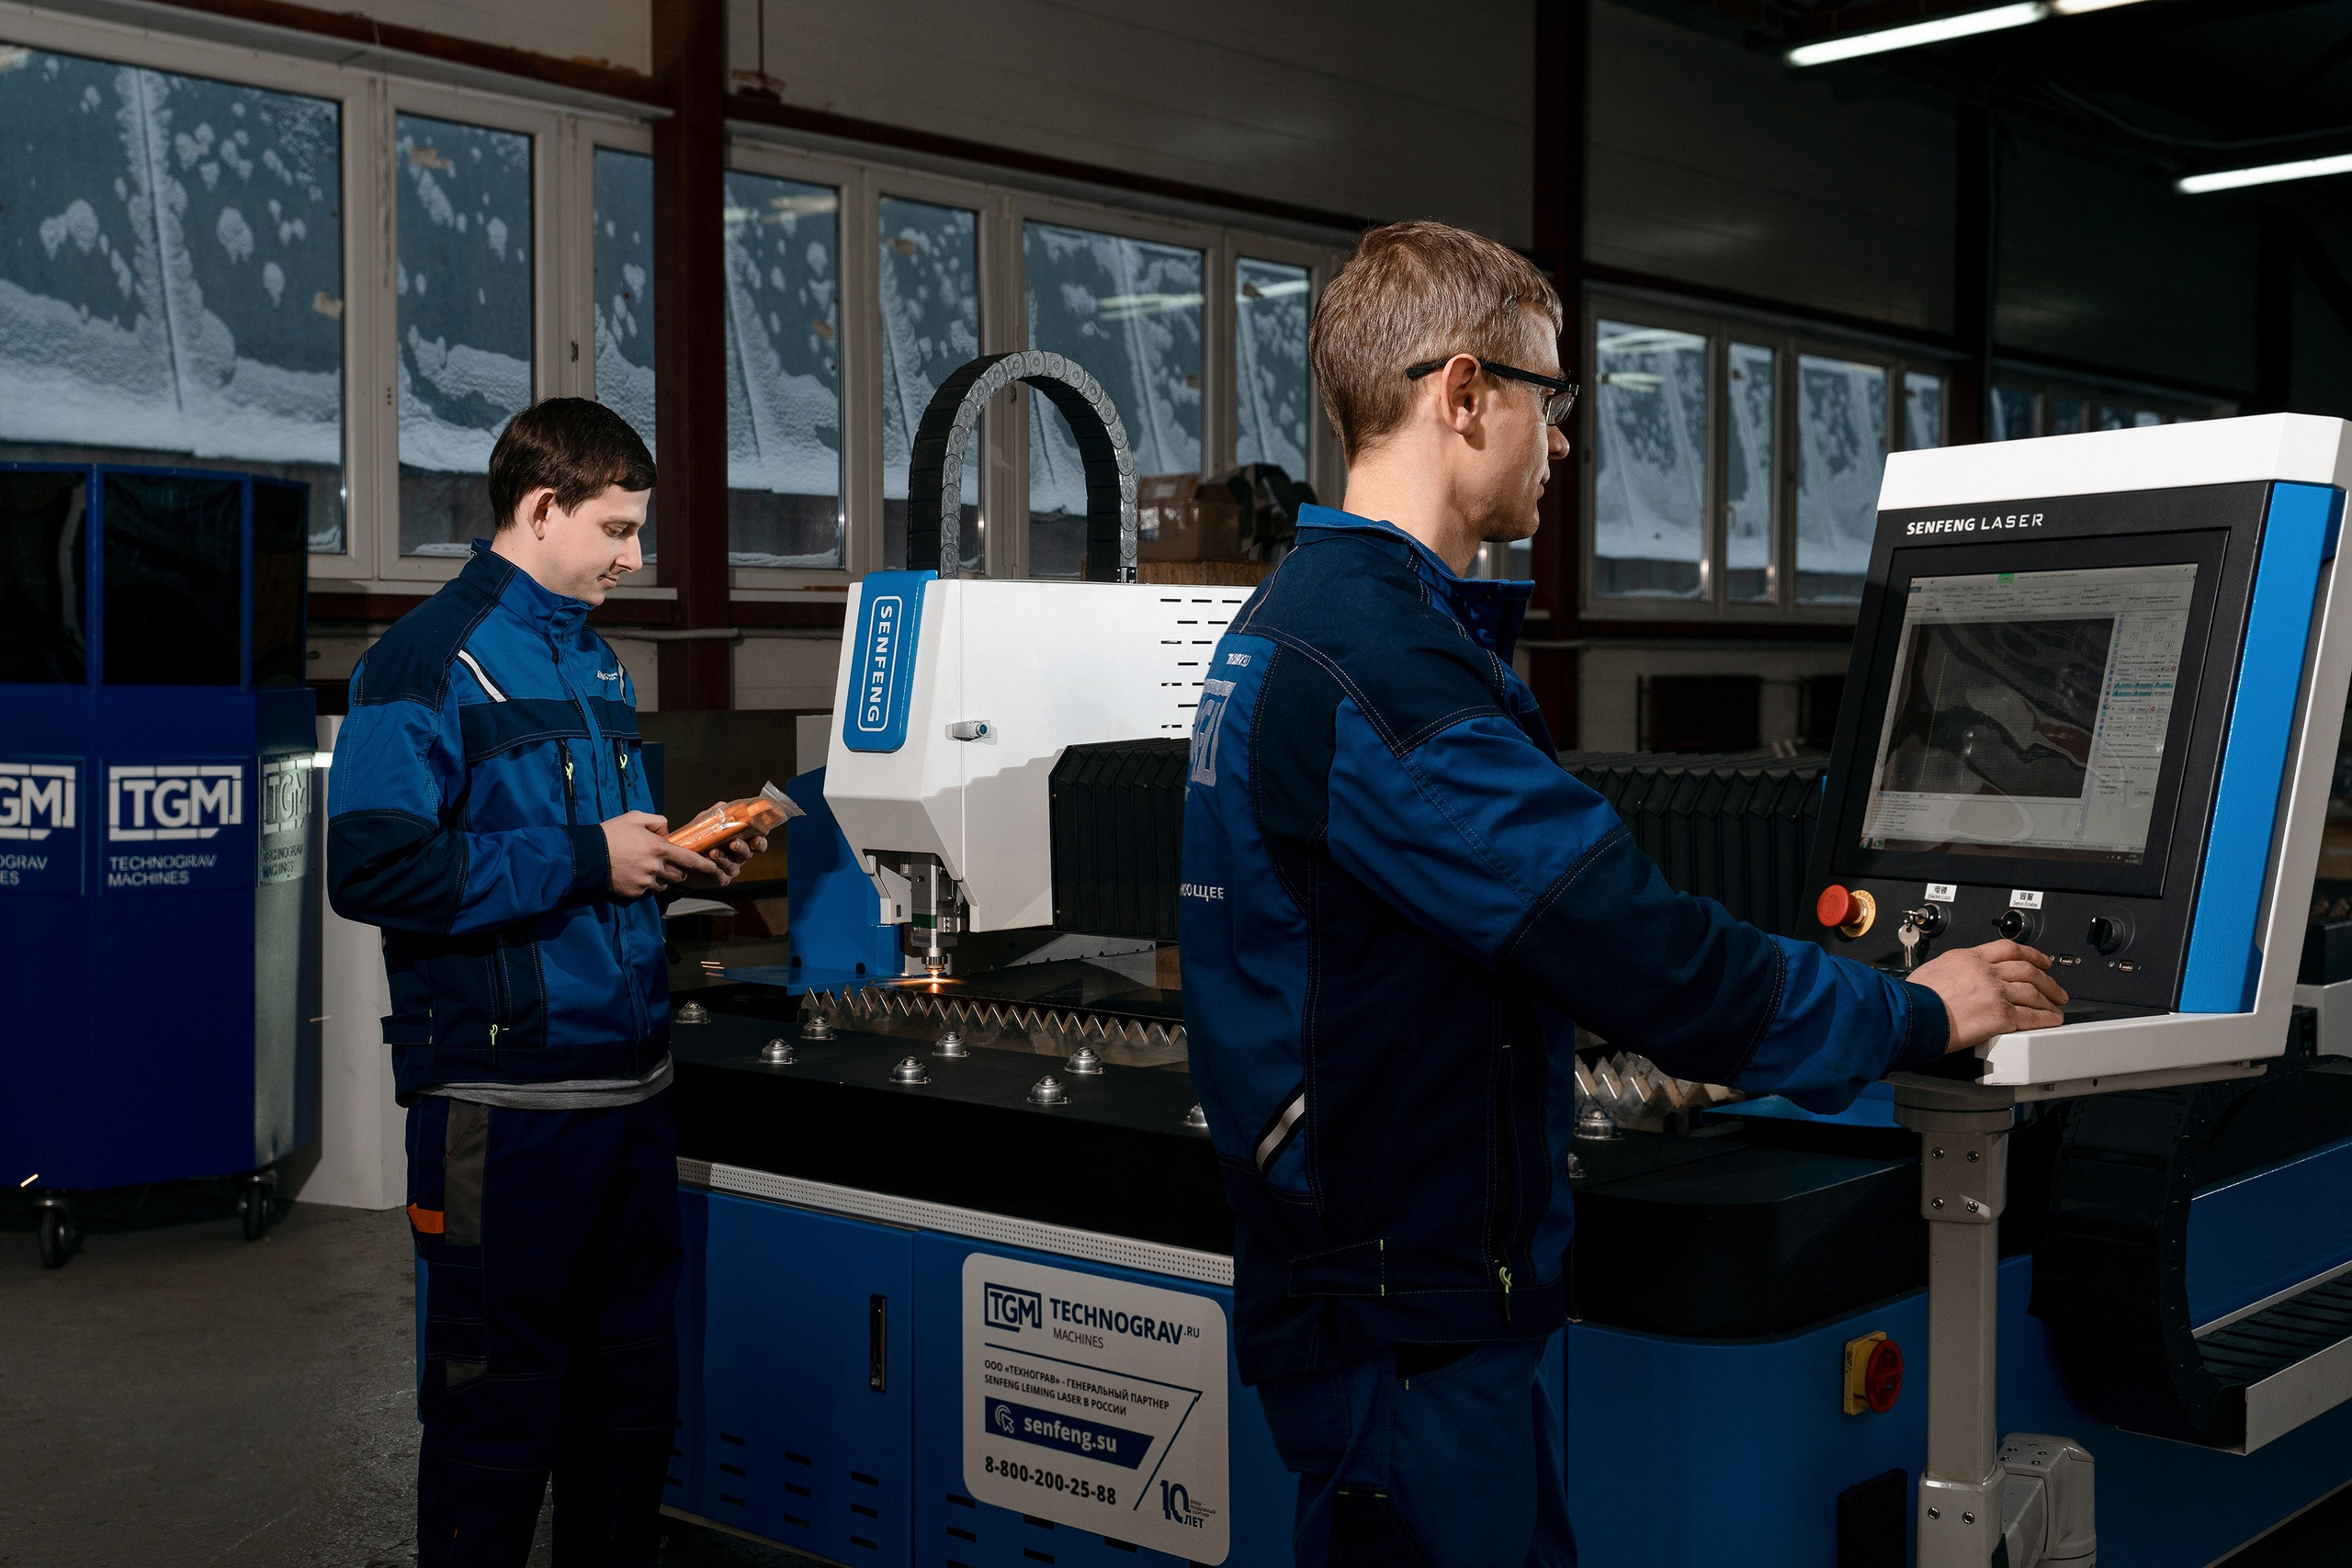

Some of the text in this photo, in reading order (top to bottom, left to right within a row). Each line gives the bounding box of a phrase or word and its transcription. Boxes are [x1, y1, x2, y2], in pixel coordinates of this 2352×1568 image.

[1906, 513, 2044, 536] SENFENG LASER
[866, 604, 893, 723] SENFENG
[122, 778, 230, 828] TGM
[107, 869, 191, 888] MACHINES
[108, 853, 218, 871] TECHNOGRAV
[989, 1290, 1037, 1328] TGM
[1053, 1327, 1104, 1349] MACHINES
[984, 1374, 1020, 1391] SENFENG
[1021, 1382, 1056, 1399] LEIMING
[1057, 1391, 1082, 1405] LASER
[1091, 1399, 1127, 1416] РОССИИ
[985, 1359, 1003, 1372] ООО
[1004, 1365, 1060, 1385] «ТЕХНОГРАВ»
[1067, 1378, 1129, 1402] ГЕНЕРАЛЬНЫЙ
[1131, 1393, 1170, 1410] ПАРТНЕР
[1023, 1417, 1117, 1452] senfeng.su
[985, 1455, 1117, 1506] 8-800-200-25-88
[1159, 1479, 1192, 1524] 10
[1183, 1514, 1204, 1529] ЛЕТ
